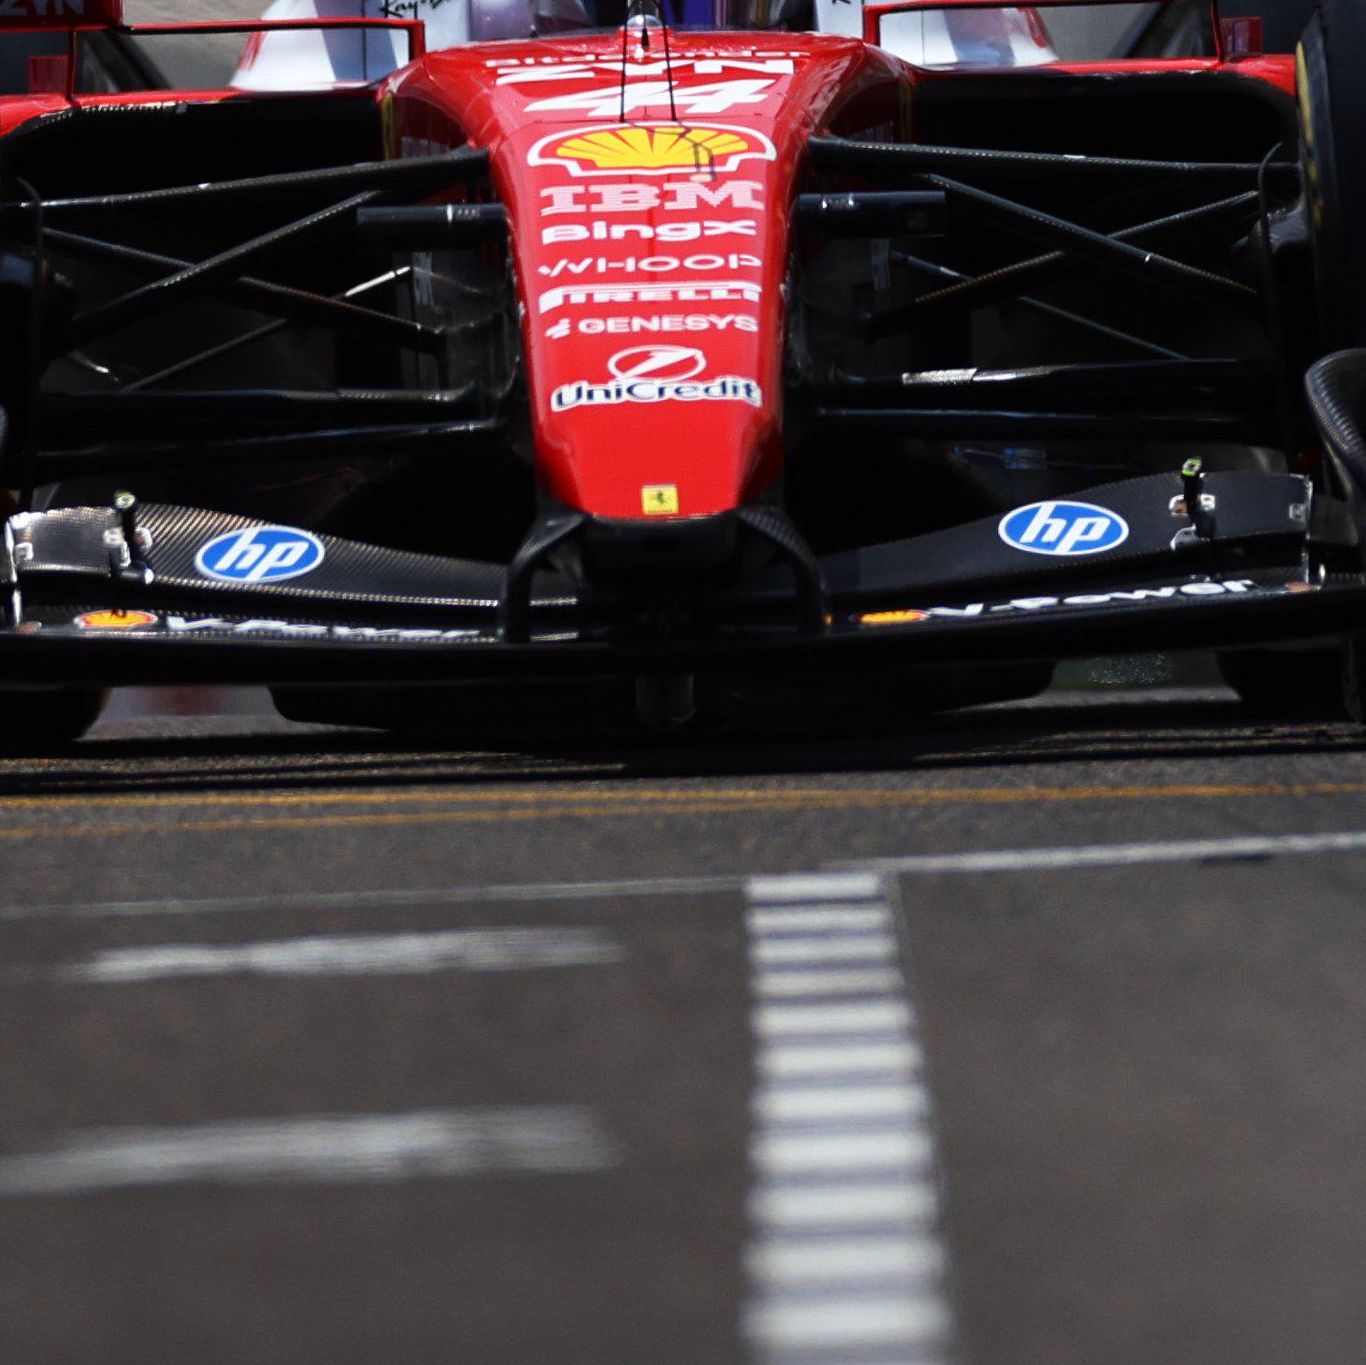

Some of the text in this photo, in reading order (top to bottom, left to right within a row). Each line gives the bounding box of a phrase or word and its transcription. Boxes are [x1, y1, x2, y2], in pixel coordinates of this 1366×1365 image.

[496, 59, 795, 85] ZYN
[524, 79, 776, 116] 44
[540, 180, 765, 216] IBM
[538, 253, 762, 277] WHOOP
[539, 281, 762, 314] PIRELLI
[578, 314, 759, 334] GENESYS
[552, 378, 761, 410] UniCredit
[1019, 501, 1111, 554] hp
[216, 526, 306, 581] hp
